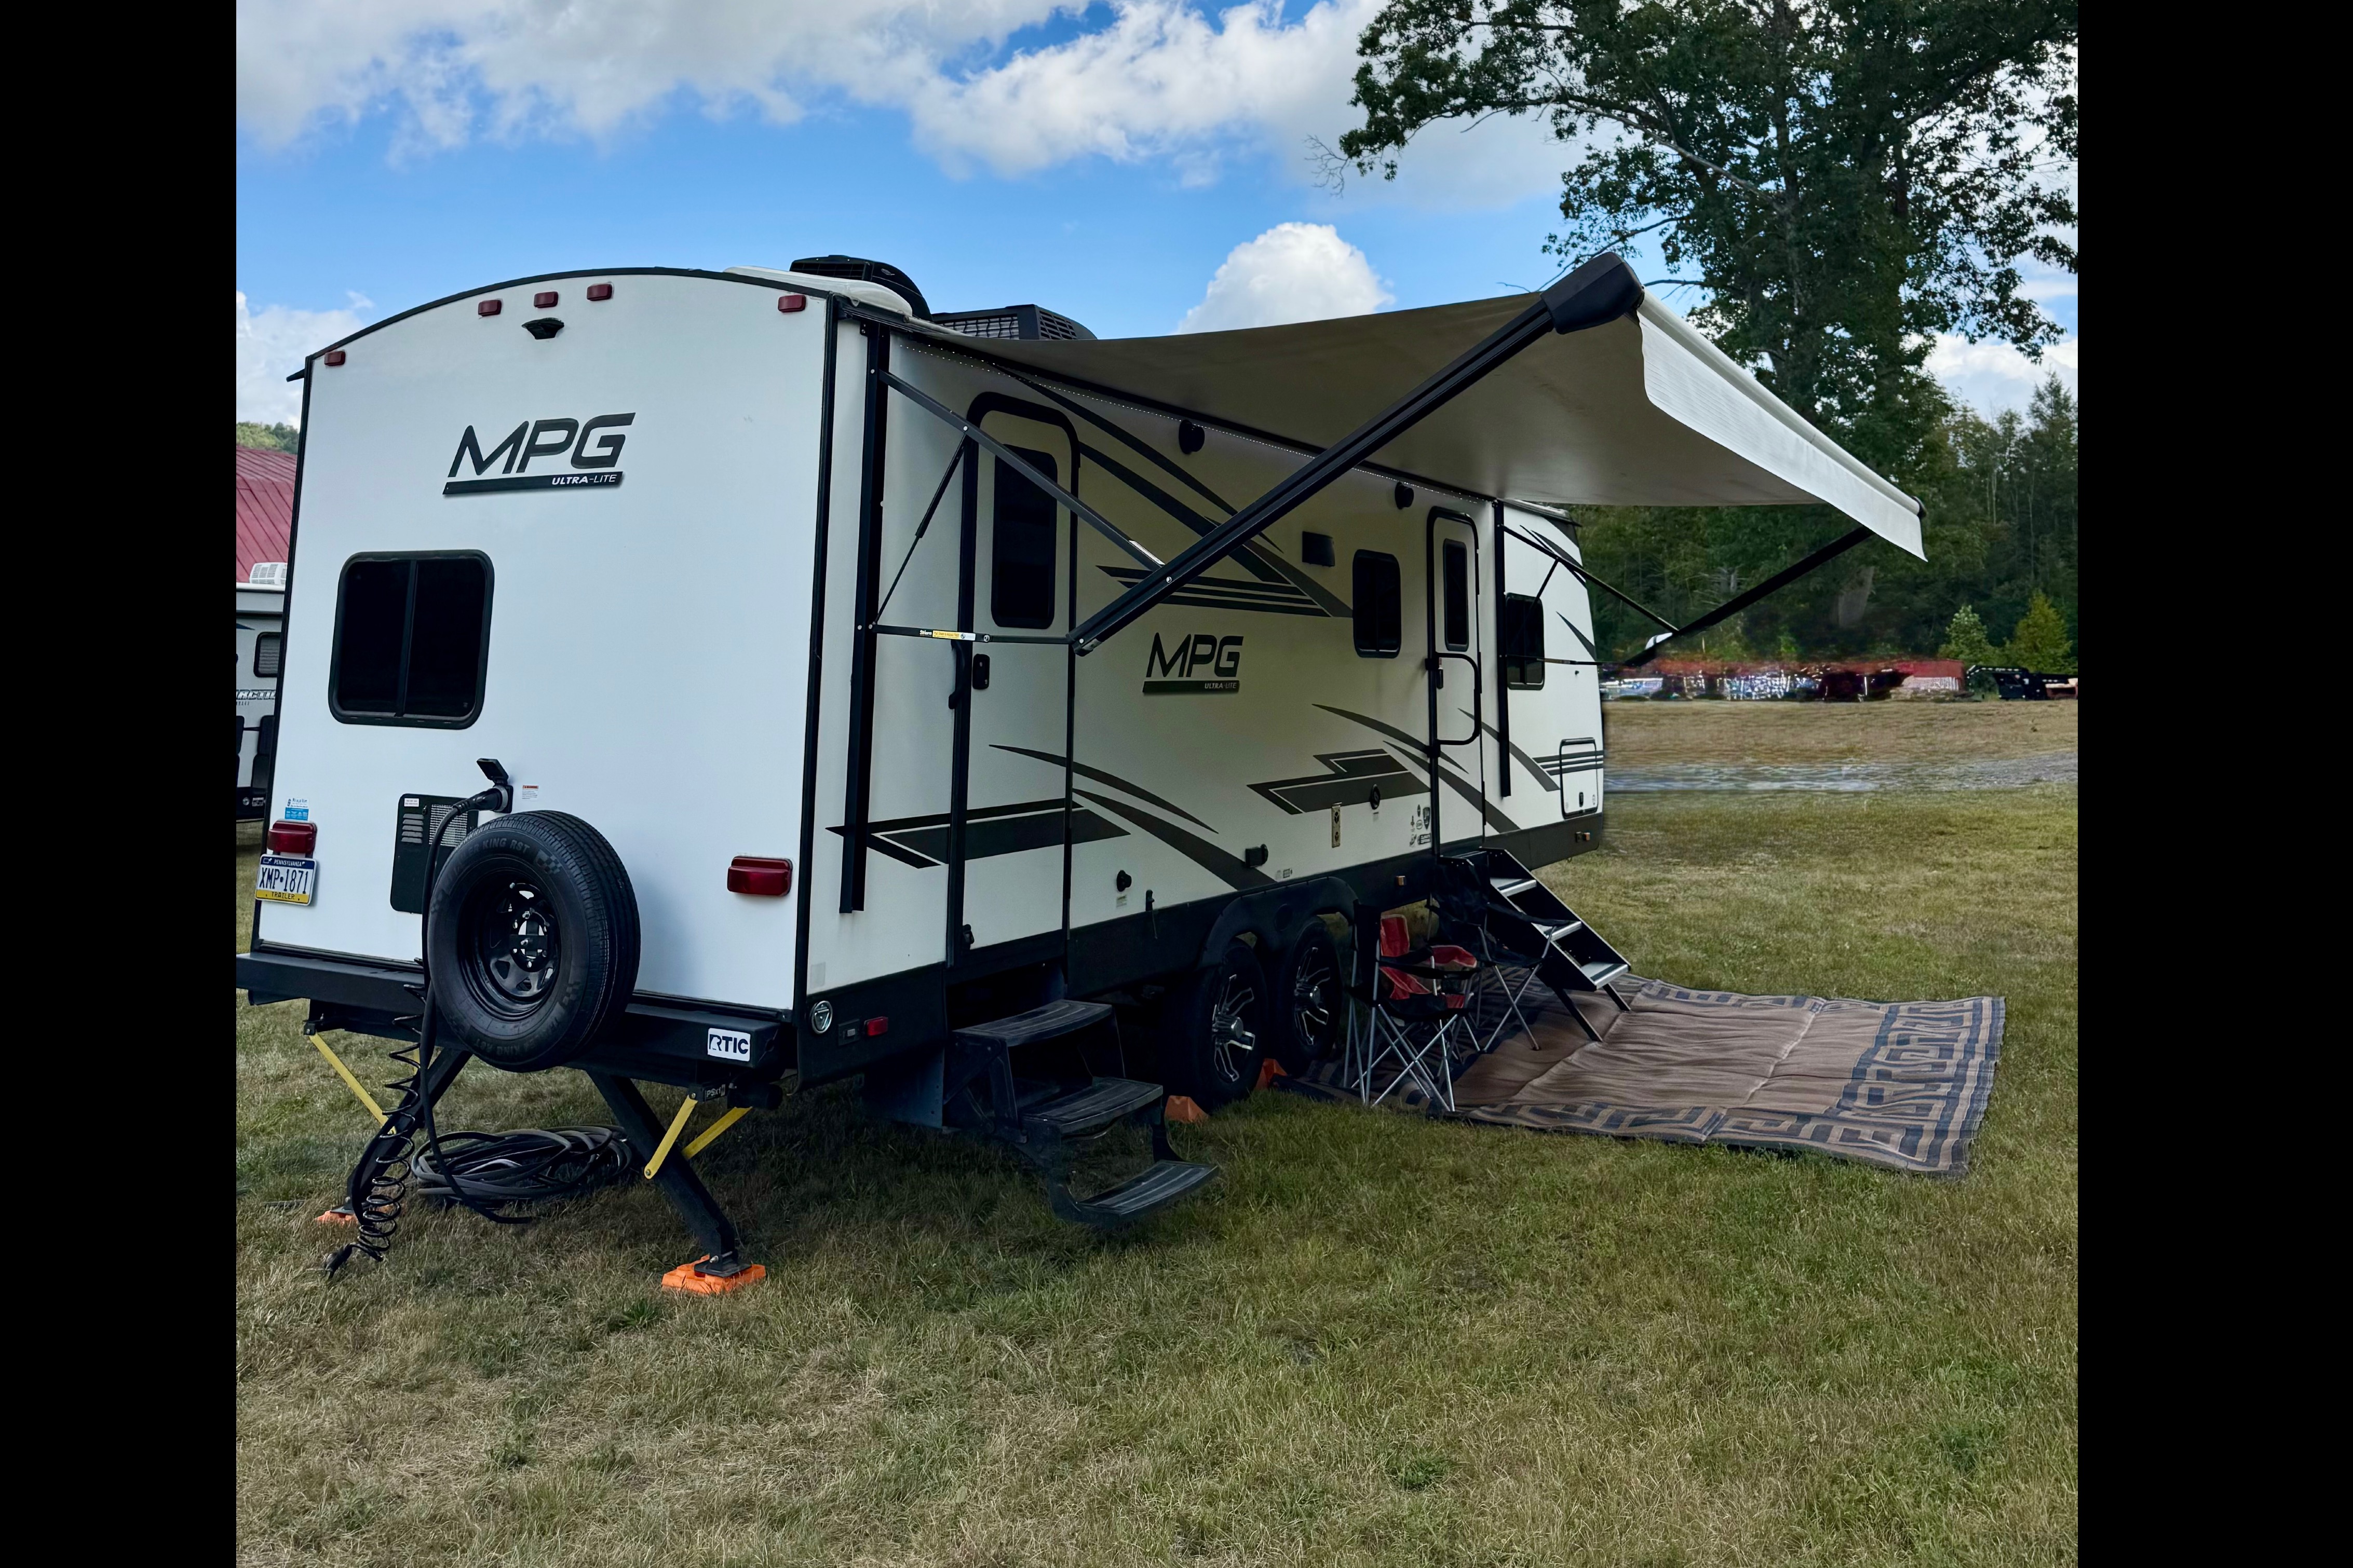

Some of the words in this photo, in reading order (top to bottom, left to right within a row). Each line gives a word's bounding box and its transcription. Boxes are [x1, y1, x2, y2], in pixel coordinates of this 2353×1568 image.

[448, 412, 635, 478] MPG
[551, 474, 617, 485] ULTRA-LITE
[1145, 632, 1245, 678] MPG
[483, 838, 507, 850] KING
[509, 839, 530, 854] RST
[271, 891, 295, 900] TRAILER
[709, 1034, 749, 1055] RTIC
